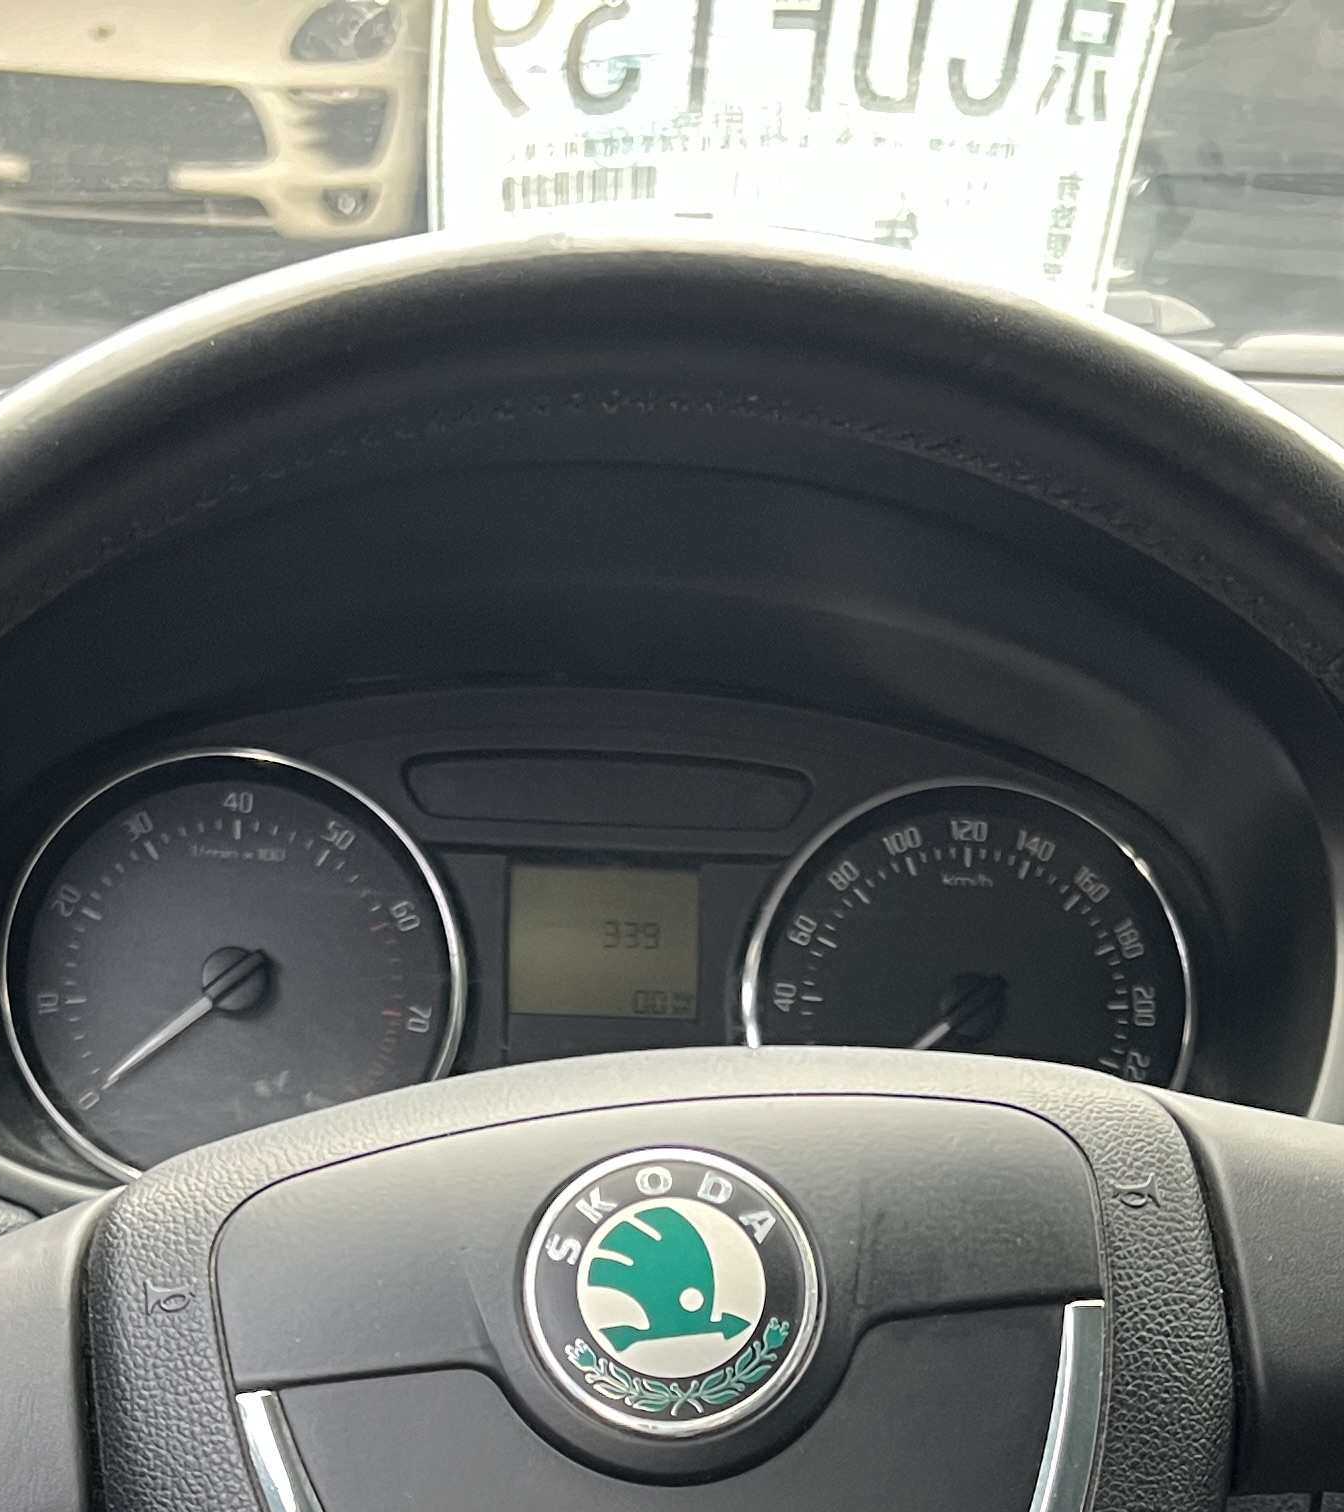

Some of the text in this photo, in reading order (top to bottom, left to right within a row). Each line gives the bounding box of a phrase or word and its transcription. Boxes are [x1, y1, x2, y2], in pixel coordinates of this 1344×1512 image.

[223, 791, 254, 814] 40
[120, 811, 154, 843] 30
[321, 820, 356, 851] 50
[882, 826, 922, 856] 100
[950, 820, 988, 843] 120
[1017, 830, 1056, 862] 140
[827, 860, 860, 892] 80
[1073, 865, 1110, 903] 160
[54, 883, 82, 918] 20
[389, 900, 420, 932] 60
[603, 921, 661, 950] 339
[788, 915, 818, 946] 60
[1114, 917, 1145, 959] 180
[37, 992, 59, 1014] 10
[773, 982, 798, 1012] 40
[1132, 986, 1156, 1028] 200
[407, 1005, 433, 1034] 70
[78, 1090, 101, 1112] 0
